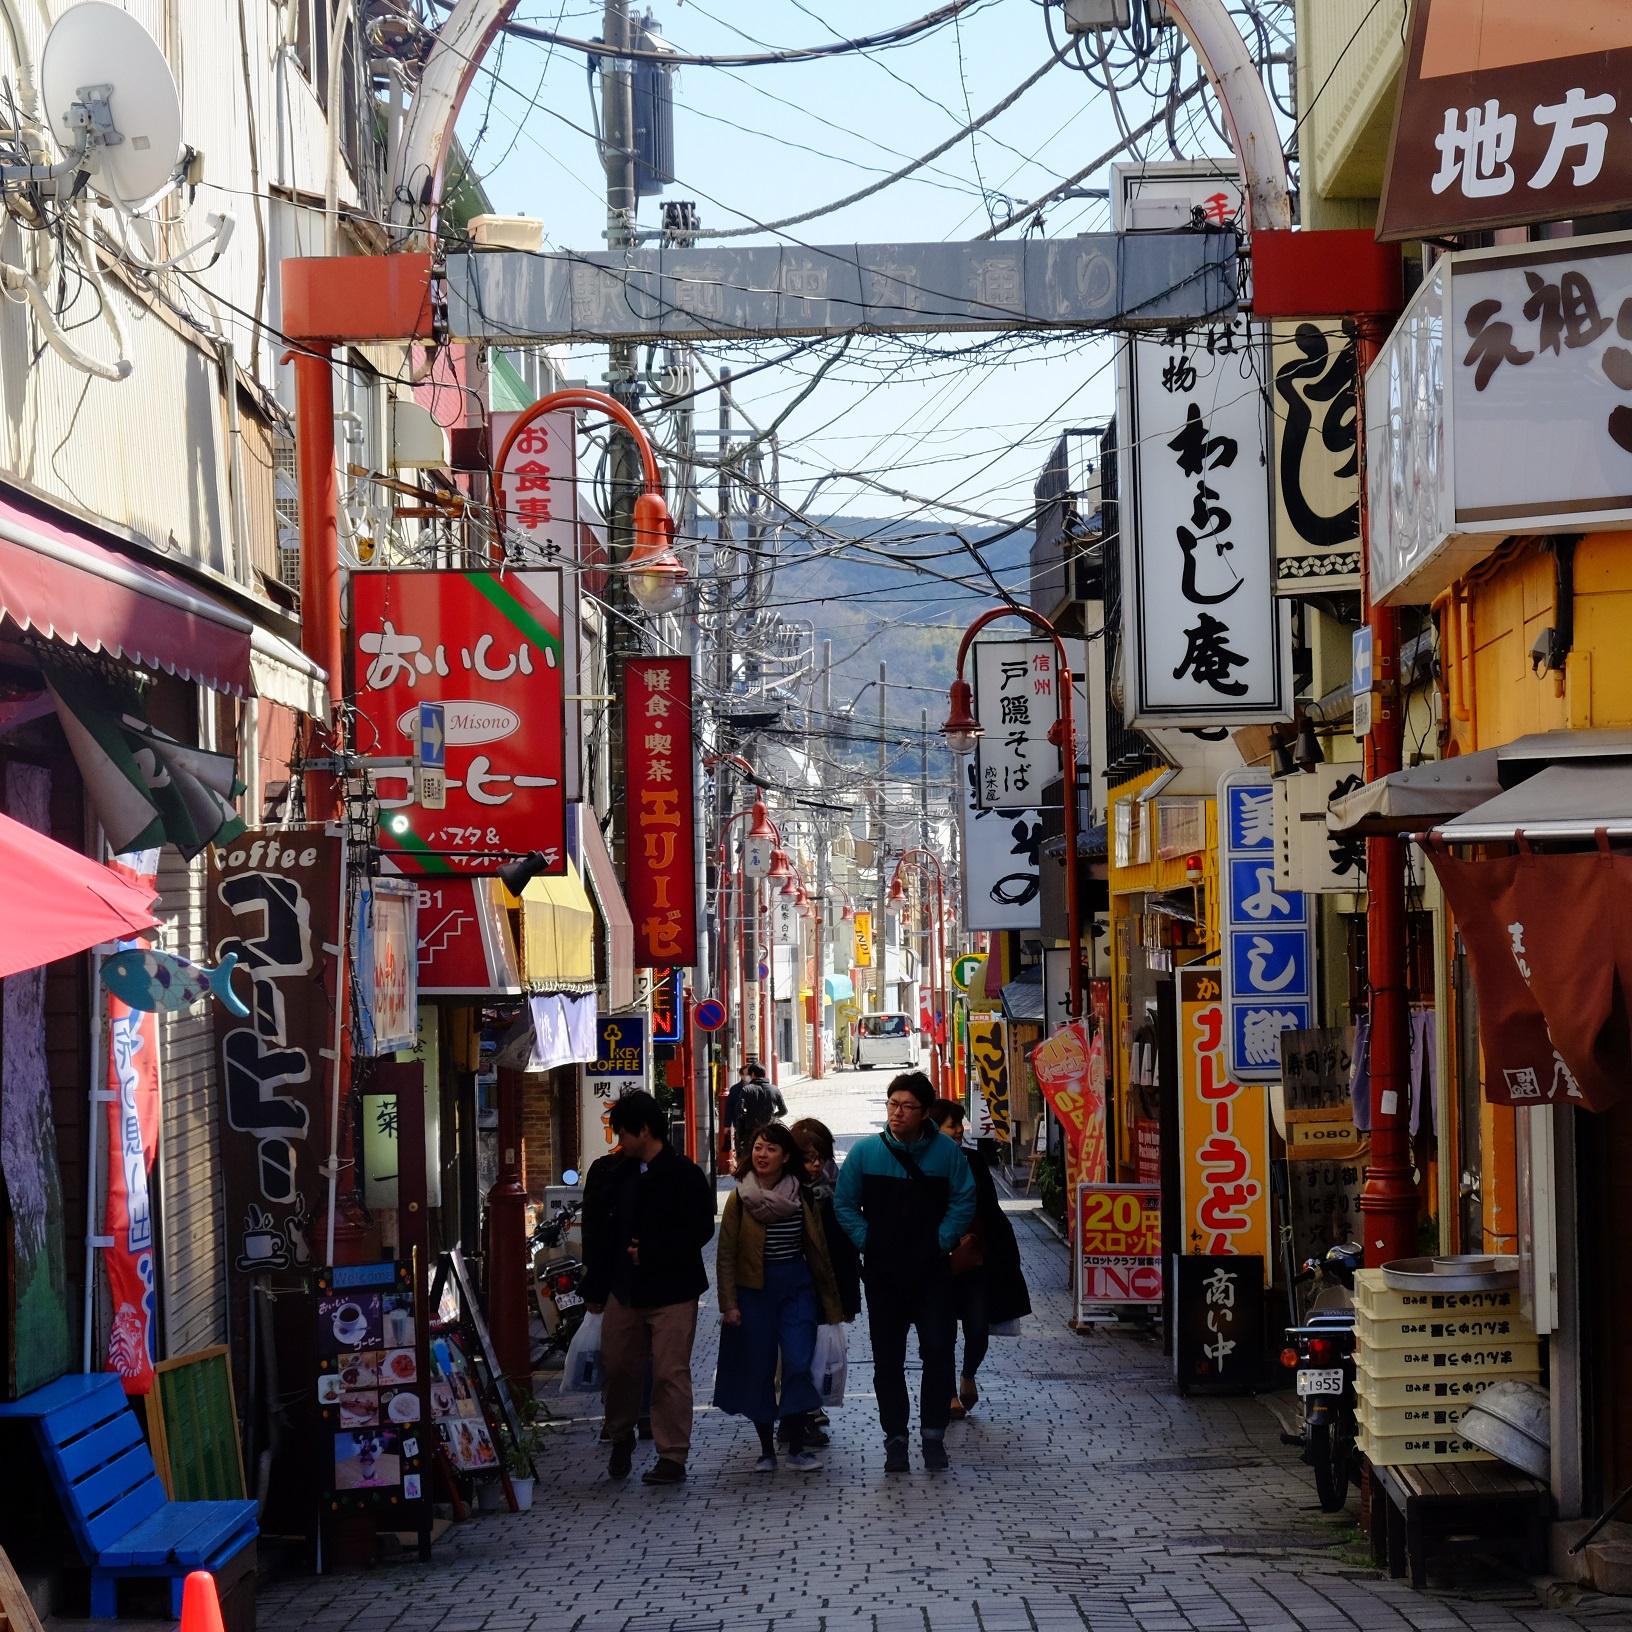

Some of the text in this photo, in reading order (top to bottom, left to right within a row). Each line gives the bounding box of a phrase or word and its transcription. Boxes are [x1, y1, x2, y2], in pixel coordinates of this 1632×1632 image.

[1431, 88, 1632, 198] 地方
[515, 427, 552, 530] お食事
[1166, 403, 1250, 697] わらじ庵
[358, 621, 556, 690] おいしい
[1033, 654, 1051, 696] 信州
[450, 714, 511, 730] Misono
[644, 668, 680, 783] 軽食・喫茶
[1000, 661, 1033, 794] 戸隠そば
[639, 788, 683, 957] エリーゼ
[417, 889, 443, 909] B1
[588, 1059, 640, 1072] COFFEE
[616, 1047, 641, 1059] KEY
[1303, 1128, 1350, 1140] 1080
[1085, 1194, 1161, 1232] 20円
[1085, 1231, 1162, 1254] スロット
[1203, 1267, 1236, 1373] 商い中
[1431, 1321, 1510, 1337] まんじゅう屋
[1433, 1350, 1513, 1366] まんじゅう屋
[1310, 1377, 1342, 1392] 1955
